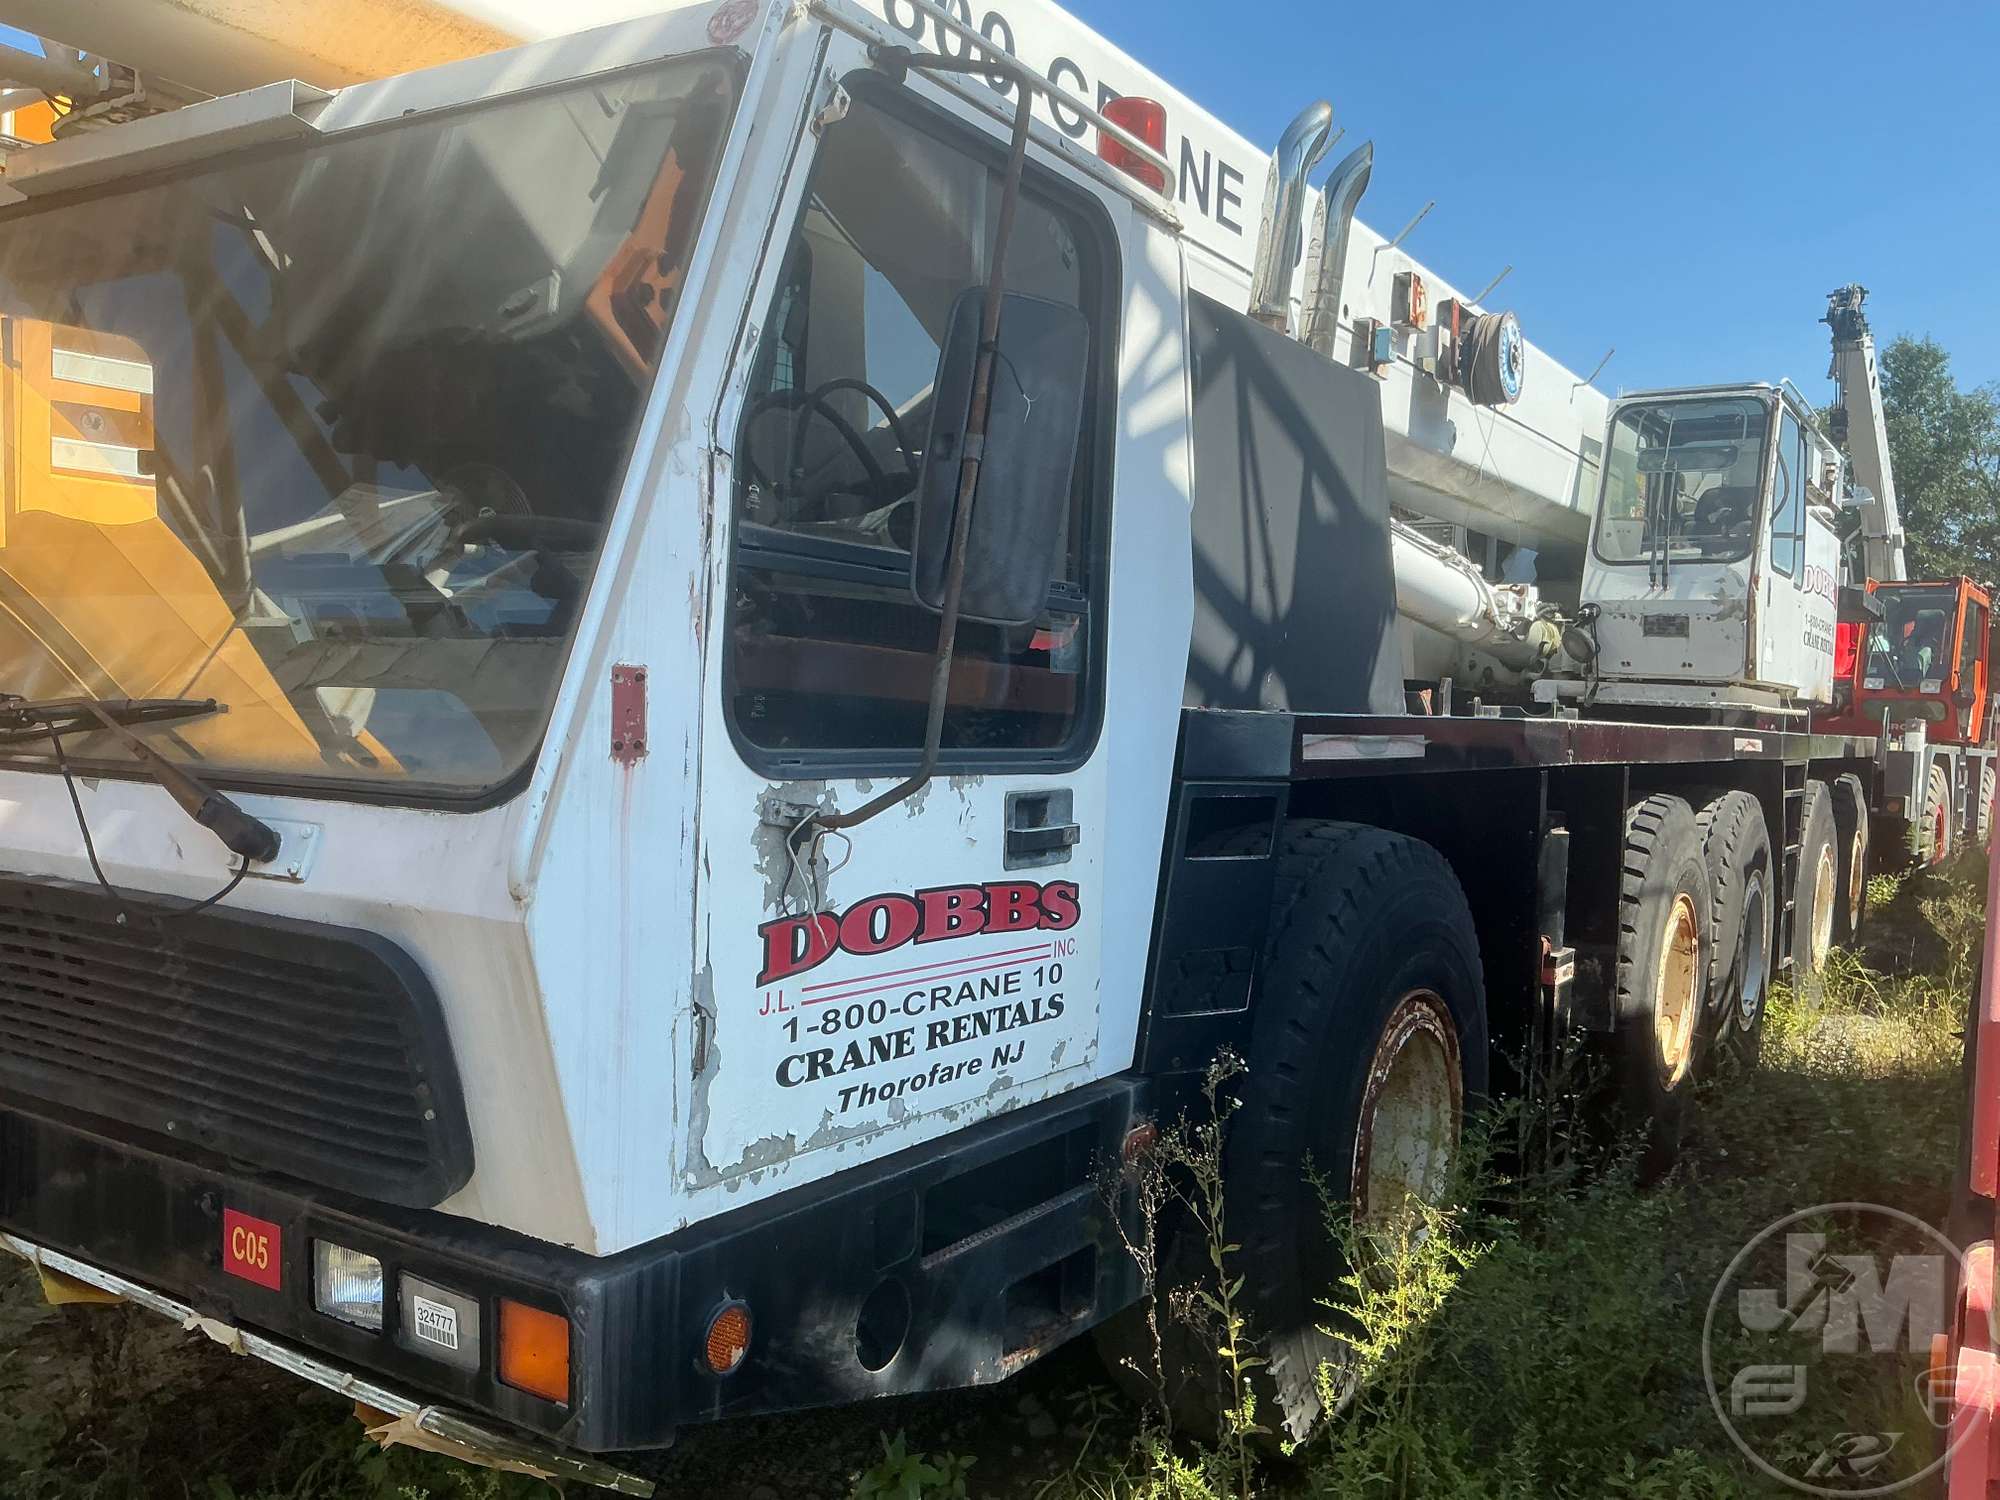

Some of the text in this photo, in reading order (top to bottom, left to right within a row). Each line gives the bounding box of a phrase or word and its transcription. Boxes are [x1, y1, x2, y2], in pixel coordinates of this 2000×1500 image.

[1803, 565, 1837, 610] DOBB
[756, 880, 1081, 988] DOBBS
[1053, 938, 1079, 958] INC.
[759, 990, 795, 1016] J.L.
[782, 963, 1063, 1043] 1-800-CRANE 10
[775, 993, 1065, 1088] CRANE RENTALS
[837, 1041, 1026, 1113] Thorofare NJ
[232, 1226, 269, 1271] C05
[417, 1306, 454, 1331] 324777
